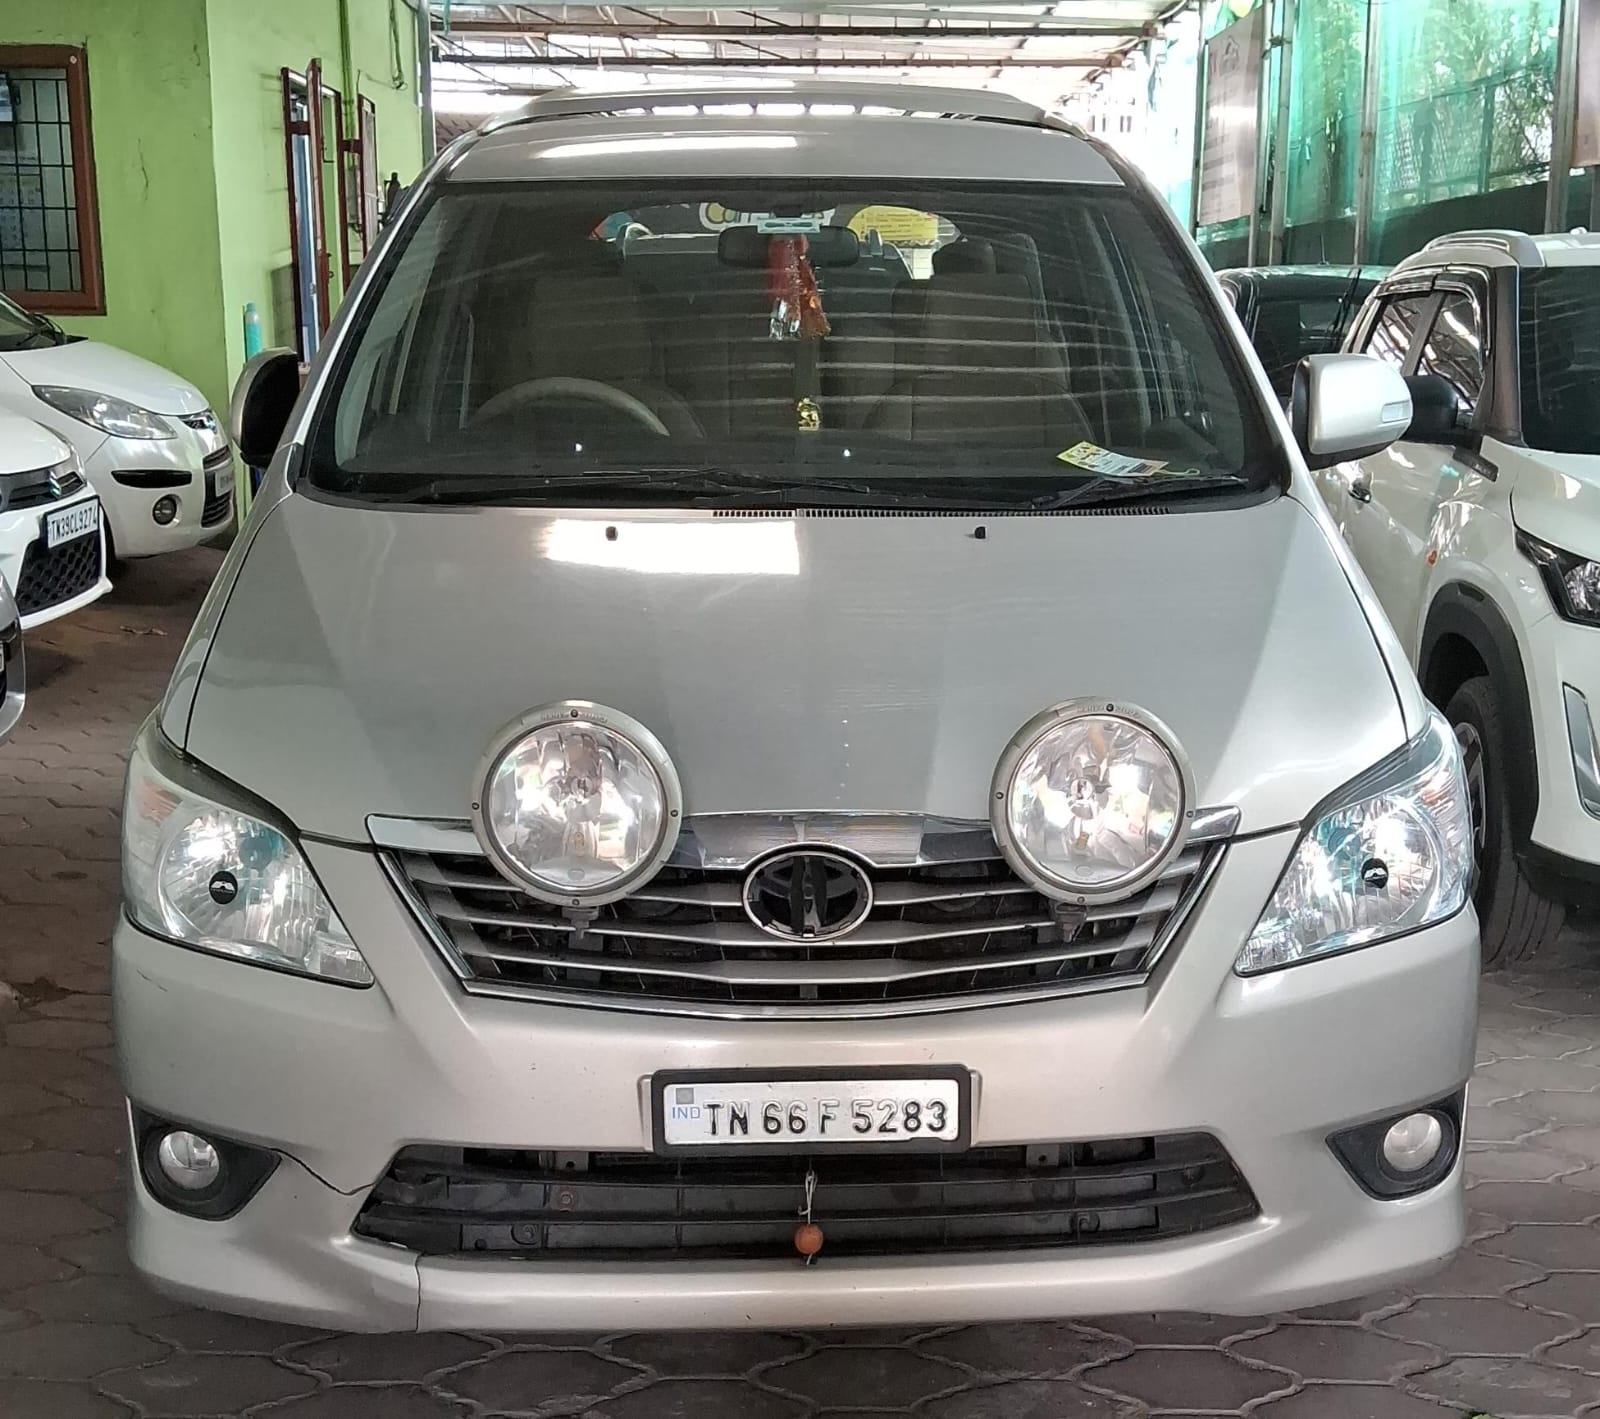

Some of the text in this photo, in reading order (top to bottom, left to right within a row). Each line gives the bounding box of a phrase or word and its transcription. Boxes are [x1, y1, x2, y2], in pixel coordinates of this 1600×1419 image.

[671, 1106, 701, 1120] IND
[703, 1099, 948, 1136] TN 66 F 5283
